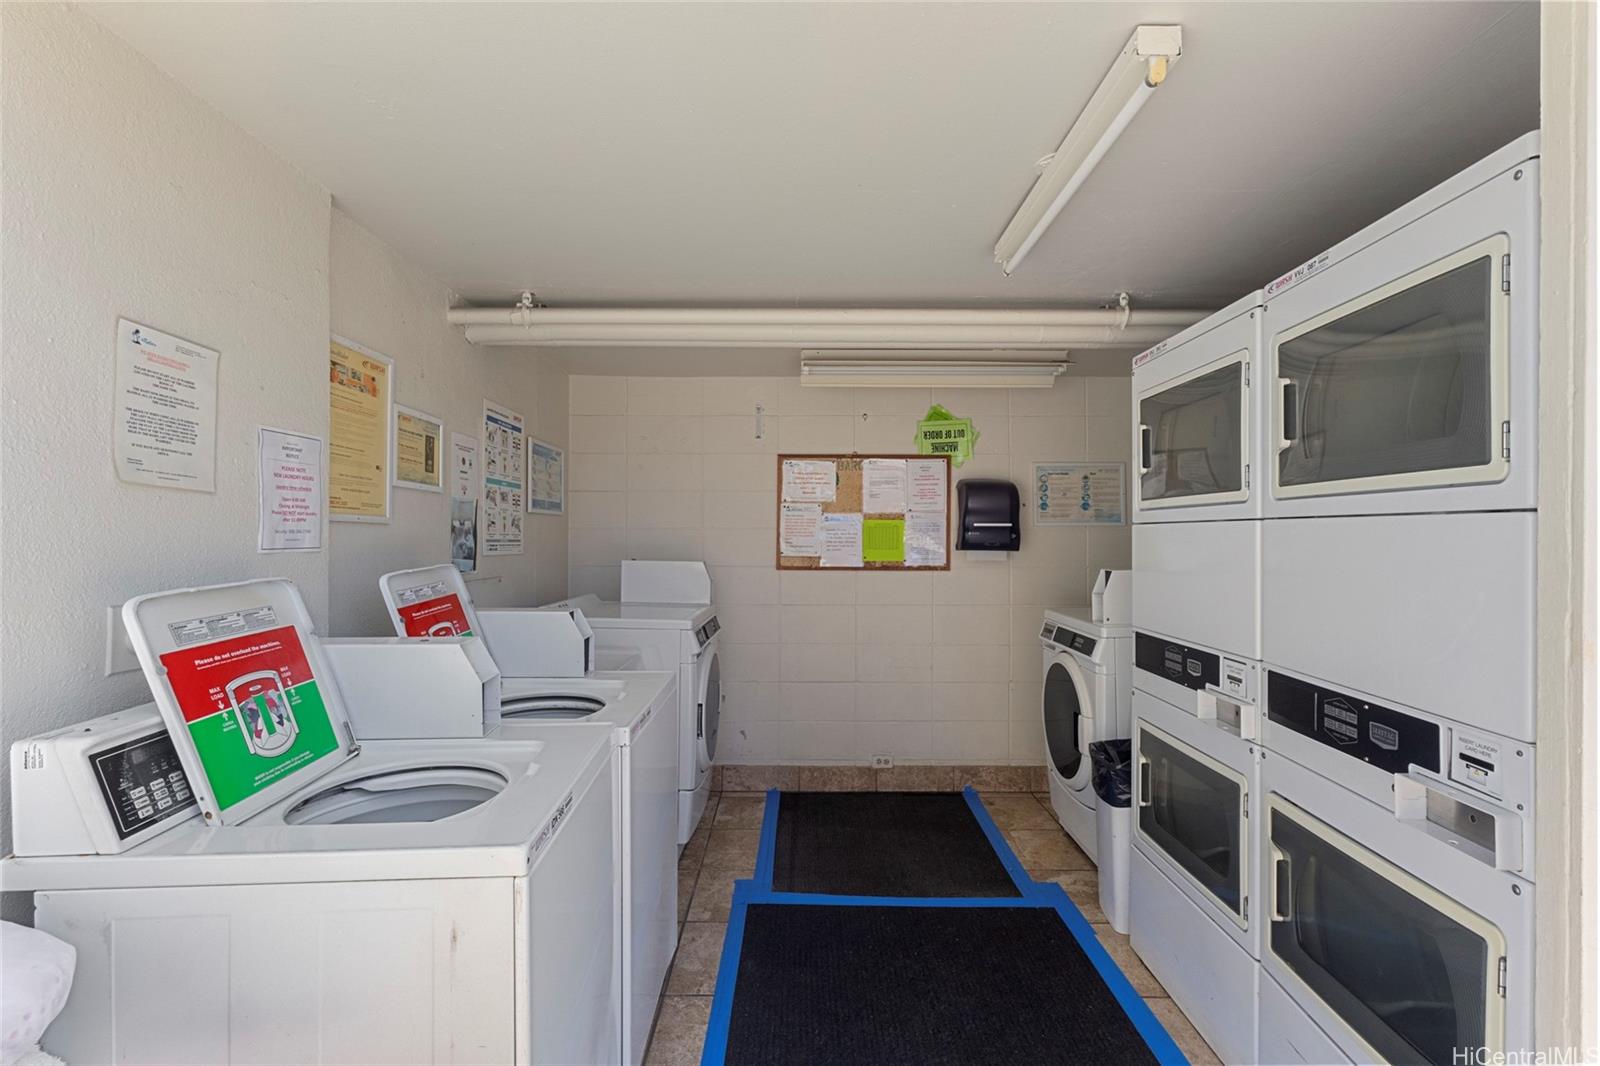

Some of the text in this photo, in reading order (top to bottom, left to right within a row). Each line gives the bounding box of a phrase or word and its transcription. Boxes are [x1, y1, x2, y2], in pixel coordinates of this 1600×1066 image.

[923, 429, 965, 440] OUT OF ORDER
[931, 442, 958, 453] MACHINE
[194, 657, 214, 666] Please
[231, 647, 251, 657] overload
